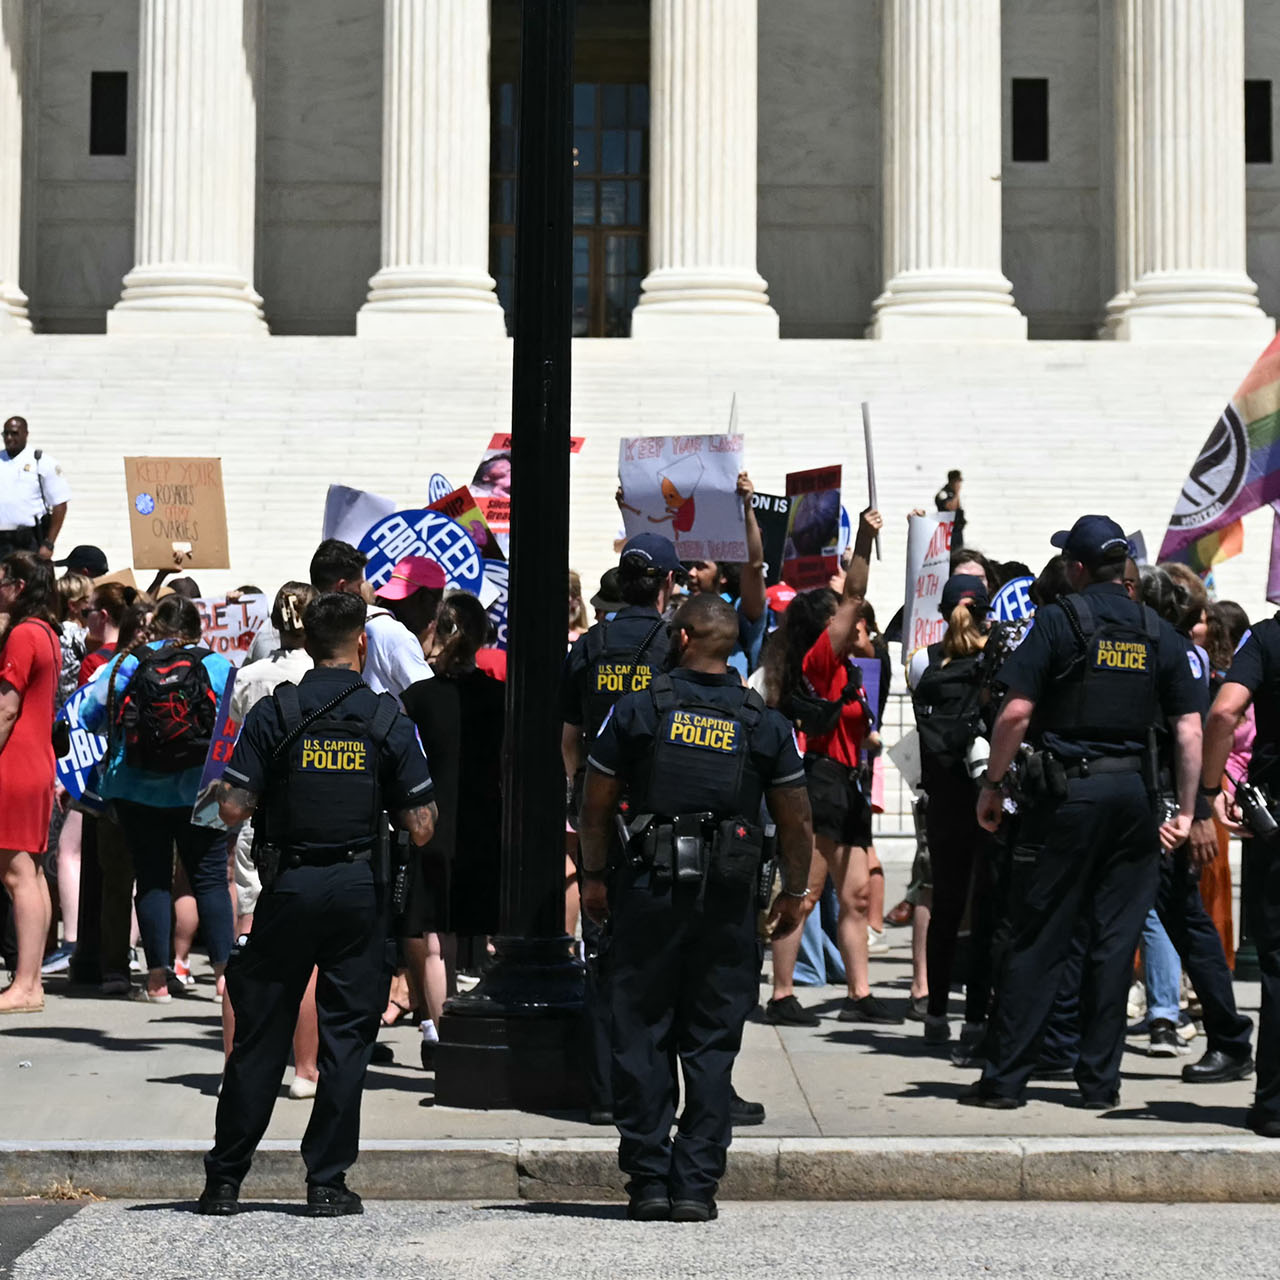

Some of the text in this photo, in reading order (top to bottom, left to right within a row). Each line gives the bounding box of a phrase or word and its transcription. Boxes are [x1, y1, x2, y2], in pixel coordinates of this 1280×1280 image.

[624, 436, 665, 462] KEEP
[672, 435, 703, 456] YOUR
[135, 461, 219, 489] KEEP YOUR
[155, 483, 195, 506] ROSARIES
[773, 498, 789, 513] IS
[152, 518, 199, 541] OVARIES
[414, 512, 481, 580] KEEP
[1099, 640, 1147, 654] U.S. CAPITOL
[598, 664, 614, 675] U.S.
[1097, 650, 1146, 670] POLICE
[674, 712, 736, 733] U.S. CAPITOL
[303, 739, 367, 753] U.S. CAPITOL
[670, 722, 736, 751] POLICE
[302, 750, 367, 771] POLICE
